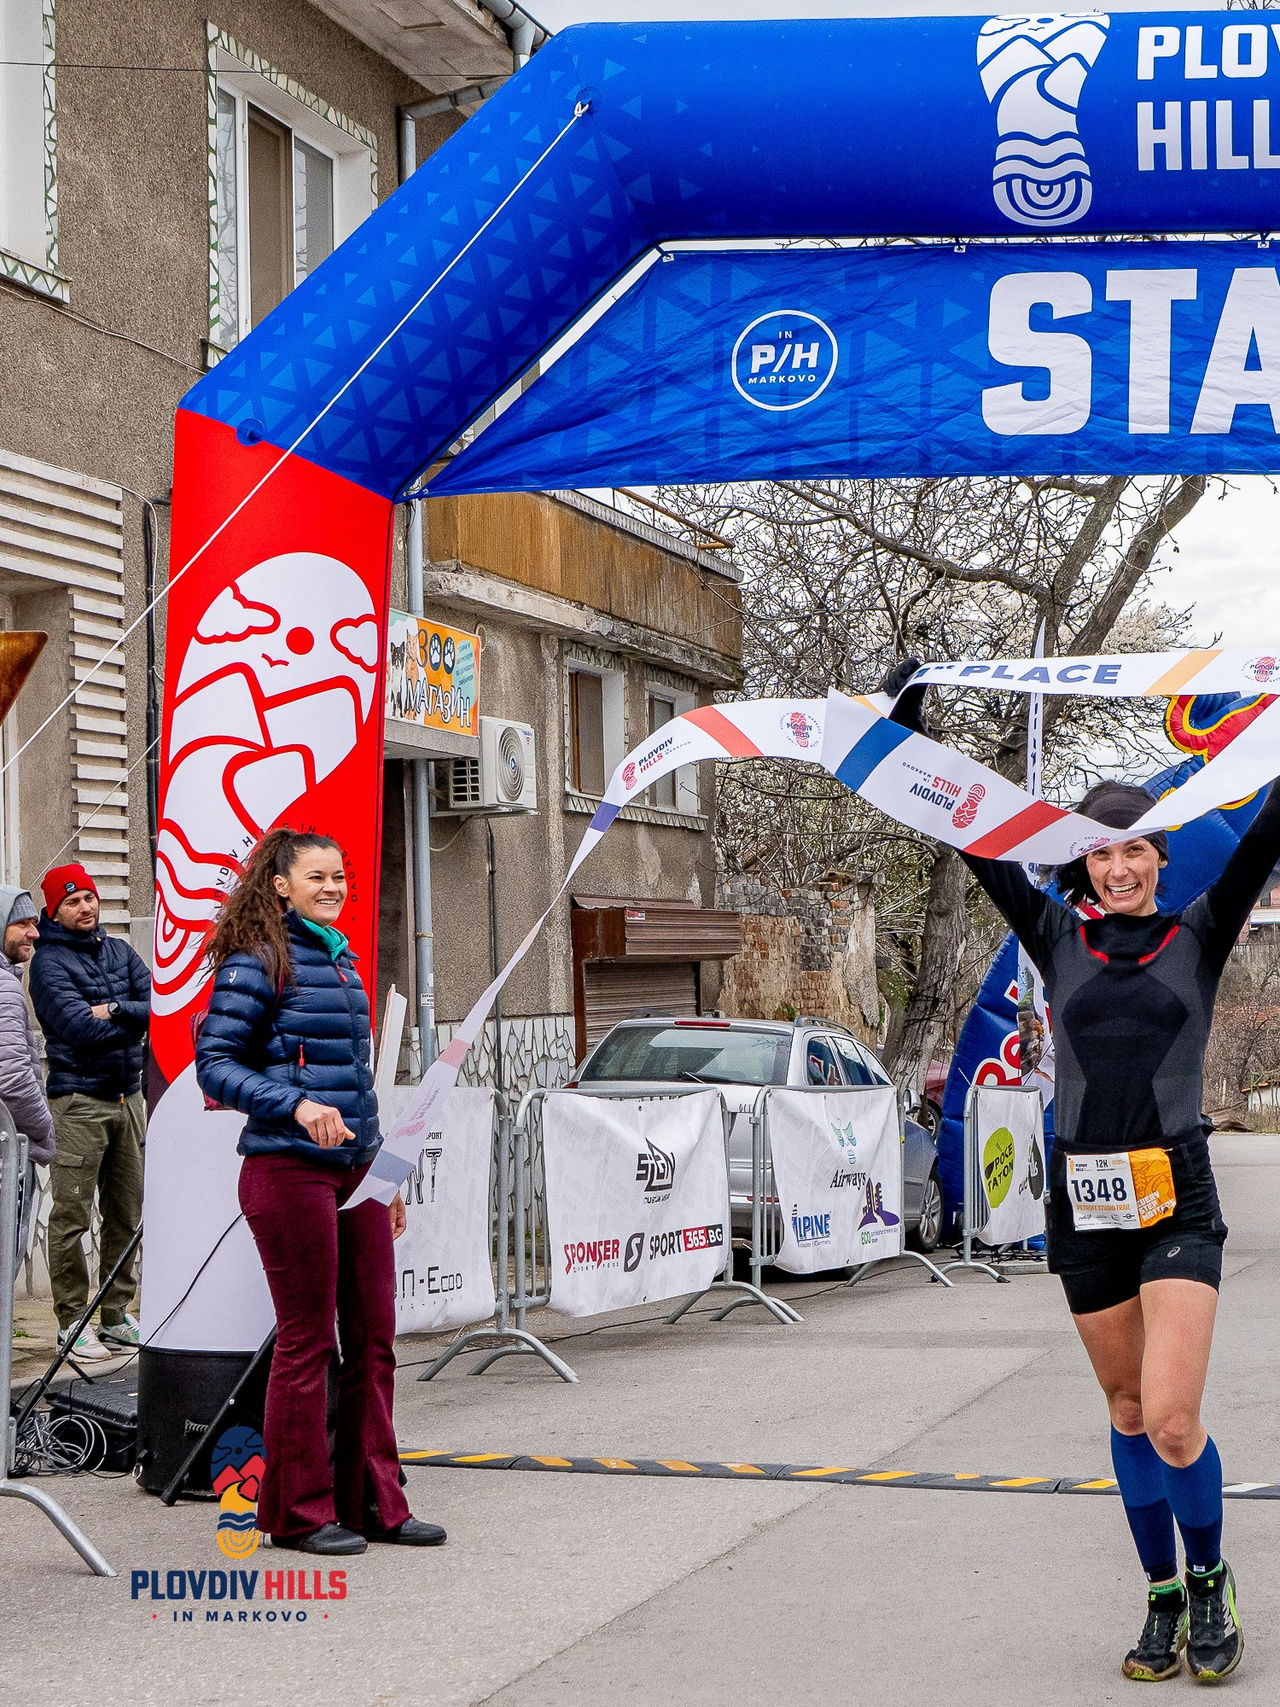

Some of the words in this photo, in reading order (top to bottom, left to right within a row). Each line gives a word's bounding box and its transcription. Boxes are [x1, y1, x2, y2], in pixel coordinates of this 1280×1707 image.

[778, 331, 793, 339] IN
[751, 342, 820, 374] P/H
[748, 374, 817, 385] MARKOVO
[959, 664, 1122, 685] PLACE
[404, 677, 471, 728] МАГАЗИН
[638, 737, 674, 767] PLOVDIV
[640, 752, 664, 774] HILLS
[909, 782, 956, 811] PLOVDIV
[931, 776, 962, 798] HILLS
[830, 1169, 867, 1191] Airways
[1071, 1177, 1128, 1202] 1348
